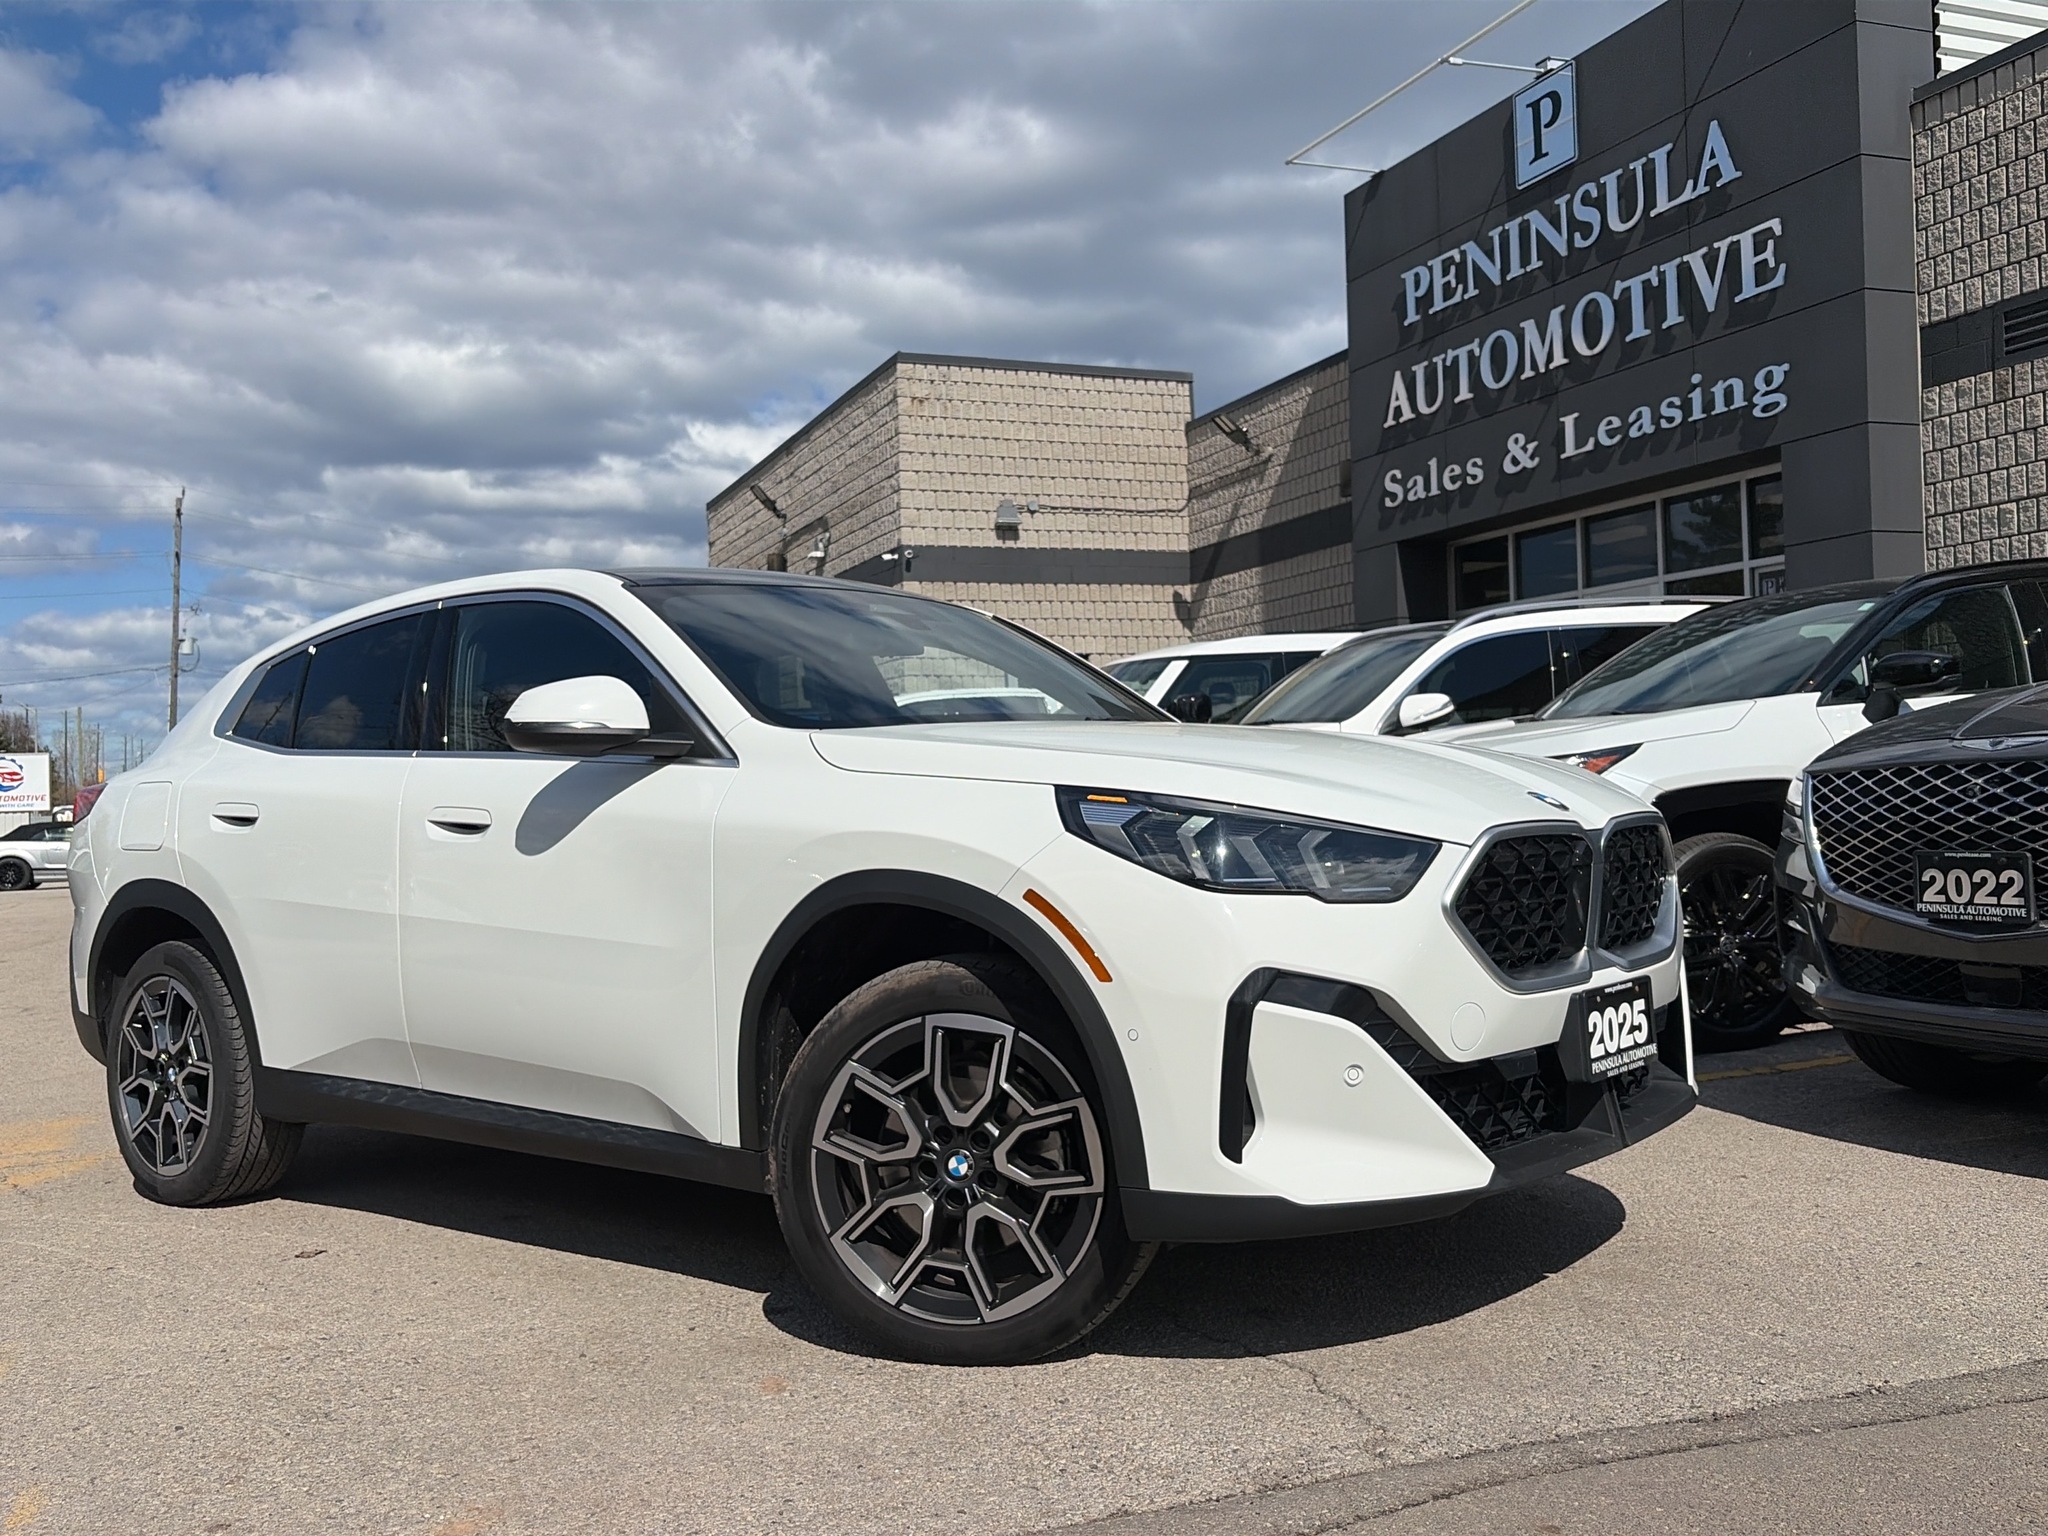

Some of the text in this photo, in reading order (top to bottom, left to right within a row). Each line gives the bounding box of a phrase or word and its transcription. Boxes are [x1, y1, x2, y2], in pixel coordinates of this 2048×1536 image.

[1526, 89, 1563, 165] P
[1400, 119, 1743, 327] PENINSULA
[1382, 217, 1787, 430] AUTOMOTIVE
[1383, 361, 1790, 509] Sales & Leasing
[1917, 903, 2027, 917] PENINSULA AUTOMOTIVE
[1921, 868, 2025, 906] 2022
[1588, 998, 1649, 1060] 2025
[1591, 1043, 1658, 1075] PENINSULA AUTOMOTIVE
[1620, 1064, 1629, 1073] AND
